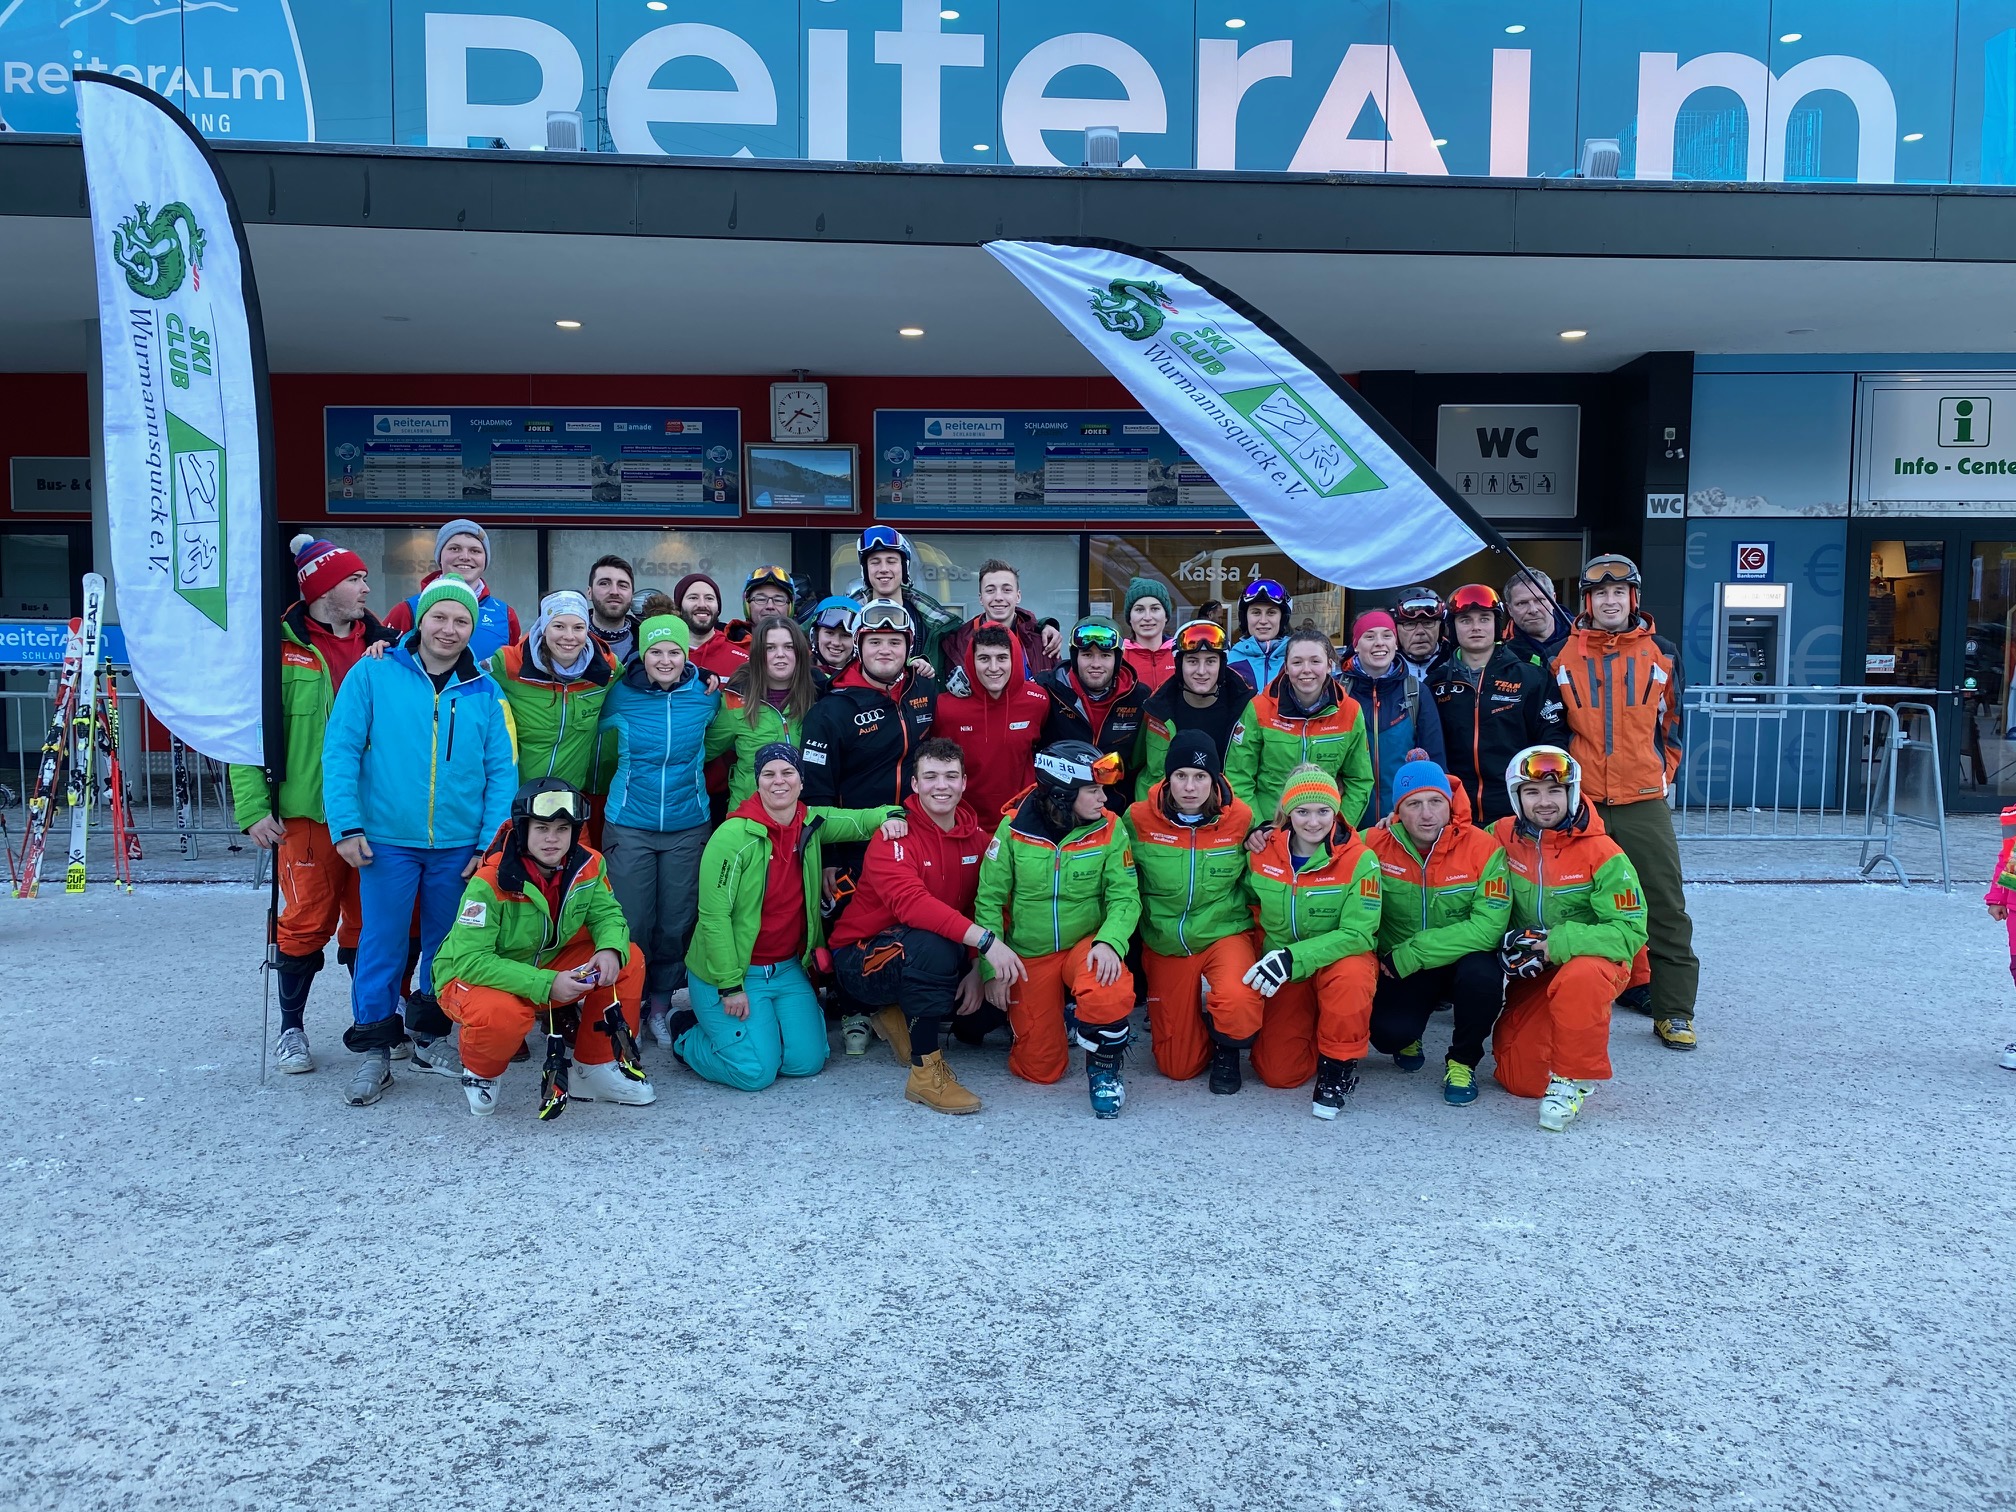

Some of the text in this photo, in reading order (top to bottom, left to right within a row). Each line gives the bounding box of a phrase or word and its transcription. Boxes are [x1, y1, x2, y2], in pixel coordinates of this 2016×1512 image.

[1194, 327, 1236, 355] SKI
[166, 312, 190, 391] CLUB
[189, 326, 212, 377] SKI
[1169, 331, 1247, 376] CLUB
[470, 419, 513, 427] SCHLADMING
[1143, 343, 1278, 473] Wurmannsquick
[1271, 470, 1310, 500] e.V.
[130, 308, 170, 575] Wurmannsquick e.V.
[1476, 427, 1539, 459] WC
[1894, 457, 1938, 475] Info
[36, 478, 67, 491] Bus-
[70, 478, 81, 491] &
[1650, 498, 1682, 514] WC
[632, 558, 691, 577] Kassa
[1179, 562, 1262, 582] Kassa 4
[85, 592, 99, 656] HEAD
[731, 649, 748, 658] CRAFT
[1495, 680, 1521, 689] TEAM
[909, 696, 928, 706] TEAM
[1027, 690, 1044, 699] CRAFT
[859, 724, 879, 735] Audi
[806, 739, 828, 750] LEKI
[67, 874, 84, 884] CUP
